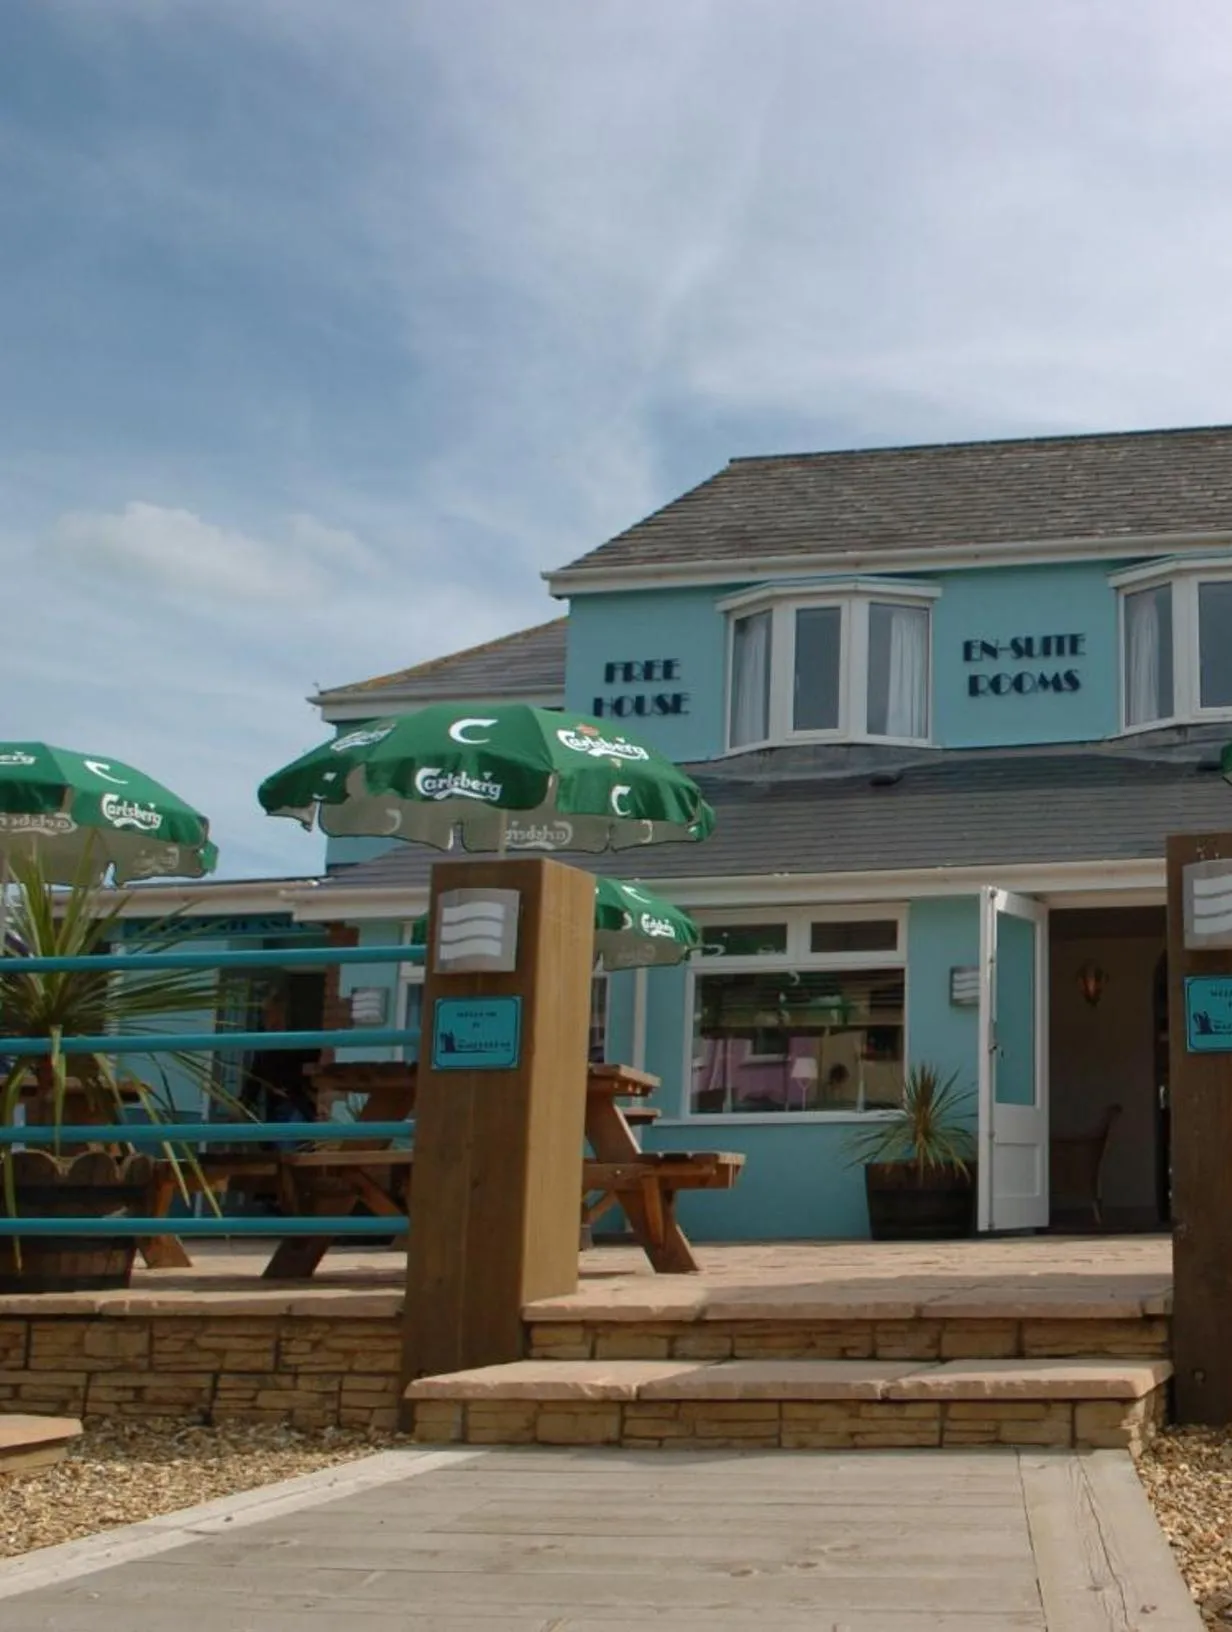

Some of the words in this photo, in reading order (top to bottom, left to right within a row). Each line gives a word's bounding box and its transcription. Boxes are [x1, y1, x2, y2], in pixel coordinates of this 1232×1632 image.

[963, 632, 1086, 662] EN-SUITE
[604, 658, 681, 684] FREE
[969, 669, 1080, 697] ROOMS
[593, 692, 691, 718] HOUSE
[415, 767, 502, 801] Carlsberg
[102, 793, 163, 830] Carlsberg
